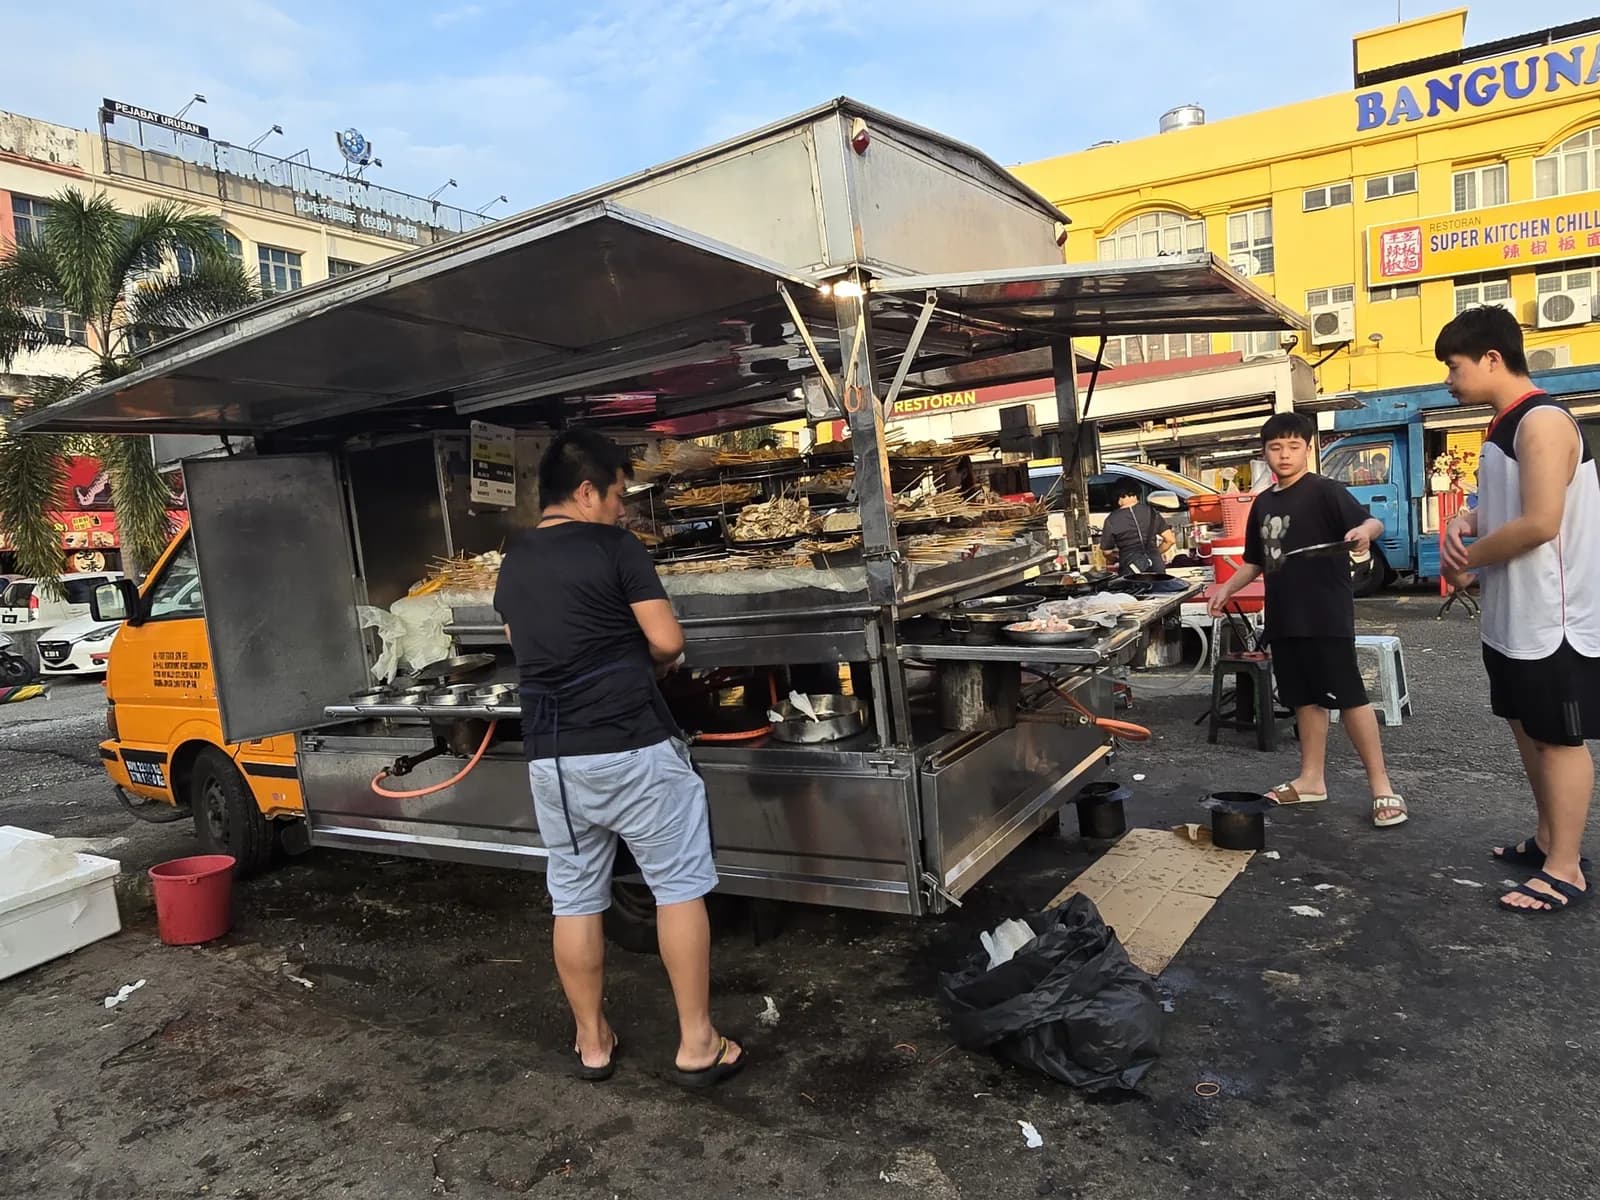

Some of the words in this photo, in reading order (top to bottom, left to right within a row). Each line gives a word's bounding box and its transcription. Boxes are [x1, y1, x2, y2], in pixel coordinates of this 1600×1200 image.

[115, 103, 159, 122] PEJABAT
[161, 116, 200, 134] URUSAN
[1429, 216, 1482, 233] RESTORAN
[1430, 229, 1479, 252] SUPER
[1484, 218, 1550, 245] KITCHEN
[894, 391, 976, 413] RESTORAN
